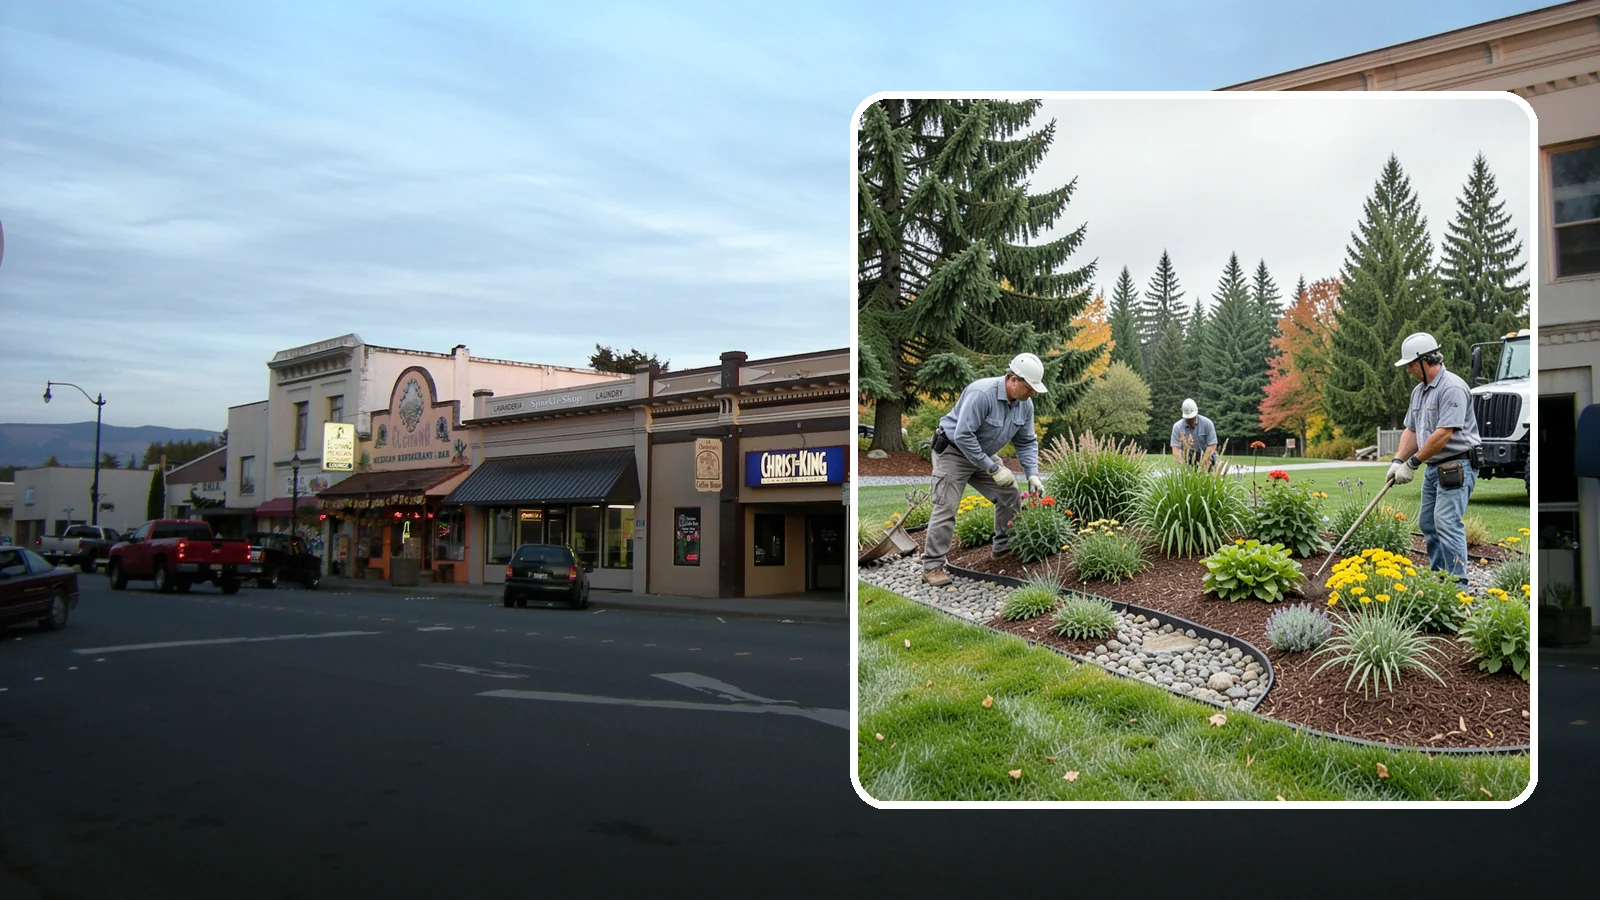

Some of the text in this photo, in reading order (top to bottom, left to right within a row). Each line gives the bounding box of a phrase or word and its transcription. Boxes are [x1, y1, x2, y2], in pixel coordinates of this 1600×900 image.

[595, 388, 624, 400] LAUNDRY
[493, 401, 523, 413] LAVANDERIA
[530, 393, 583, 410] Sparkle Shop
[373, 454, 396, 464] MEXICAN
[397, 451, 433, 462] RESTAURANT
[438, 450, 450, 459] BAR
[761, 450, 827, 477] CHRIST KING
[696, 480, 722, 489] Coffee House
